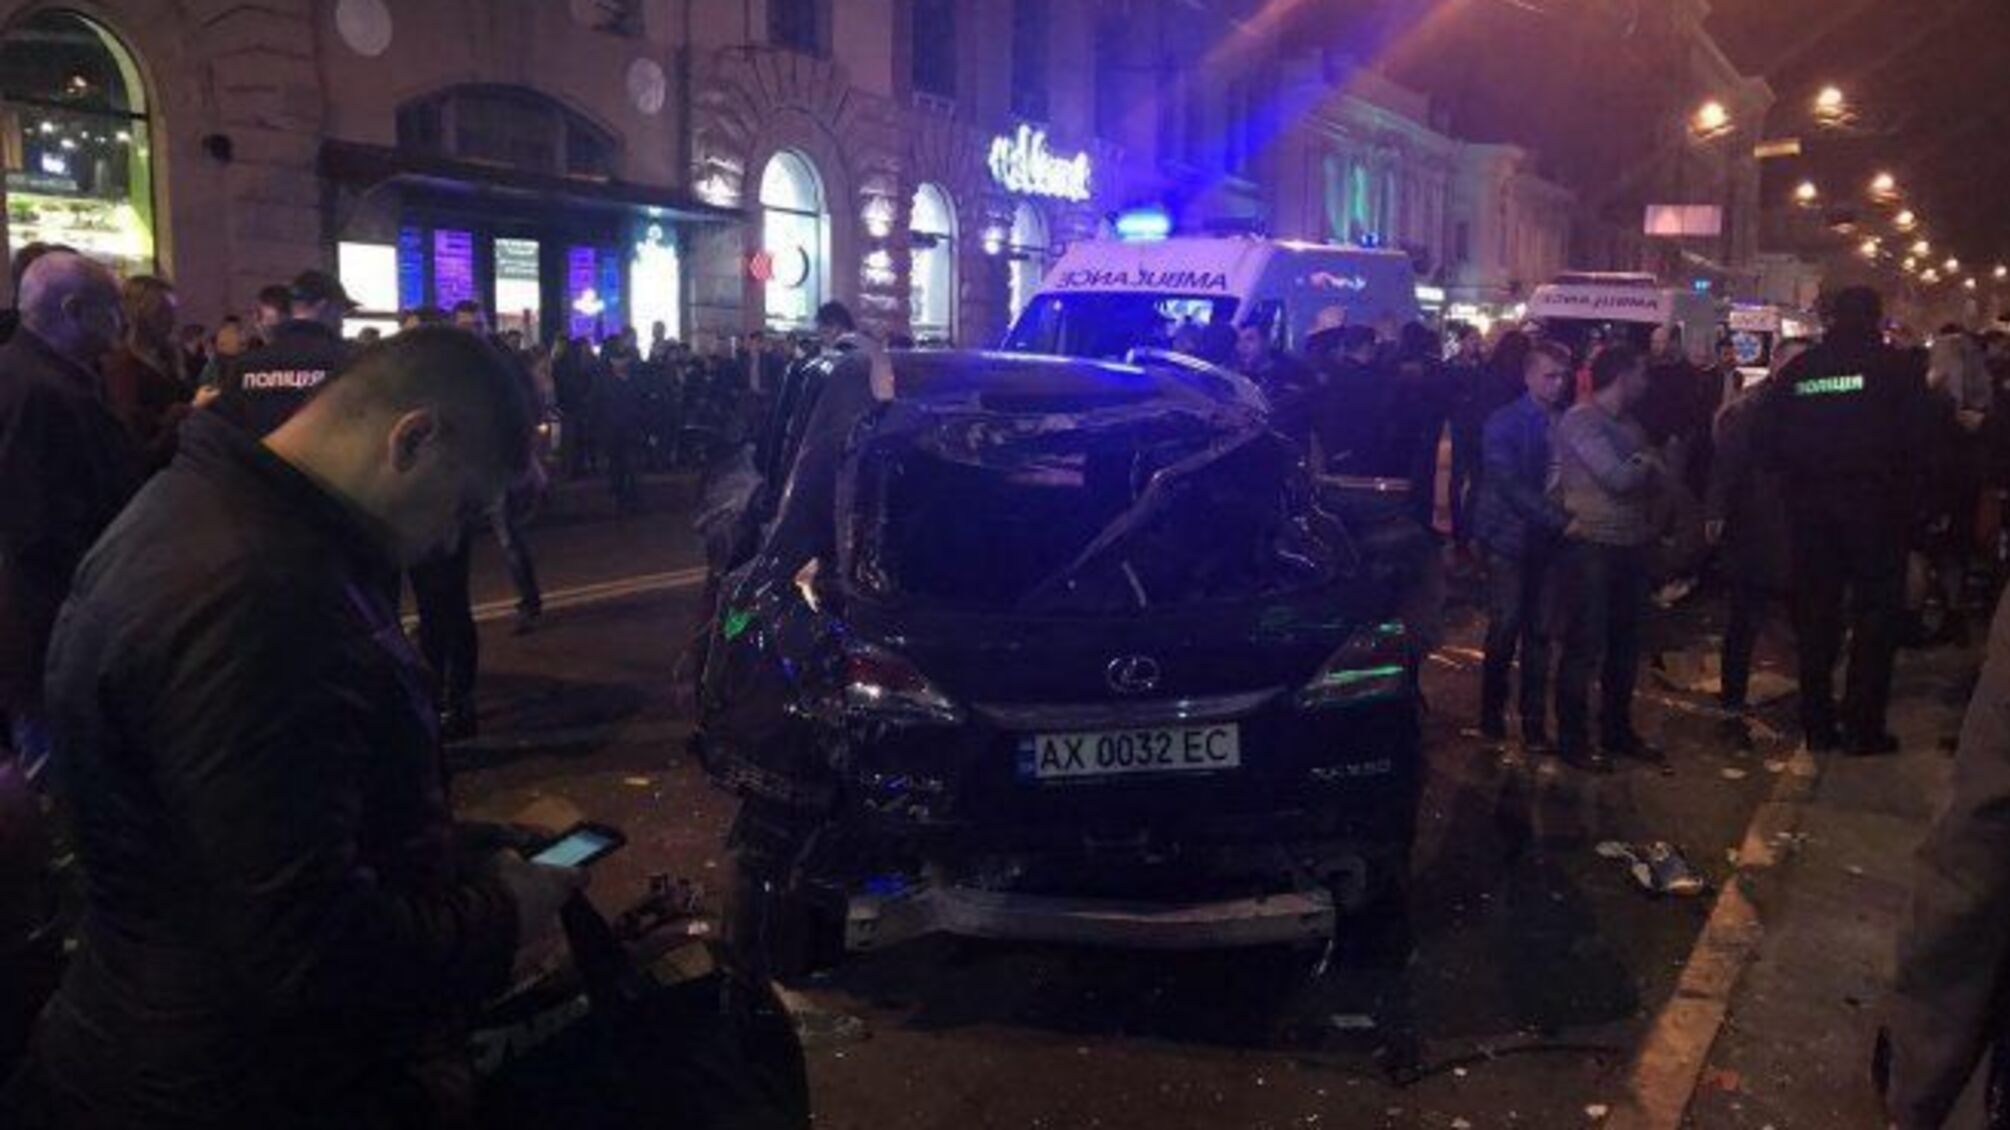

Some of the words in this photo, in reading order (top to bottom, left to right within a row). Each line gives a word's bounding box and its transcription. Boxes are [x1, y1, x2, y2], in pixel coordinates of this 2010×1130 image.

[1040, 738, 1085, 770] AX
[1096, 731, 1174, 767] 0032
[1184, 728, 1228, 763] EC
